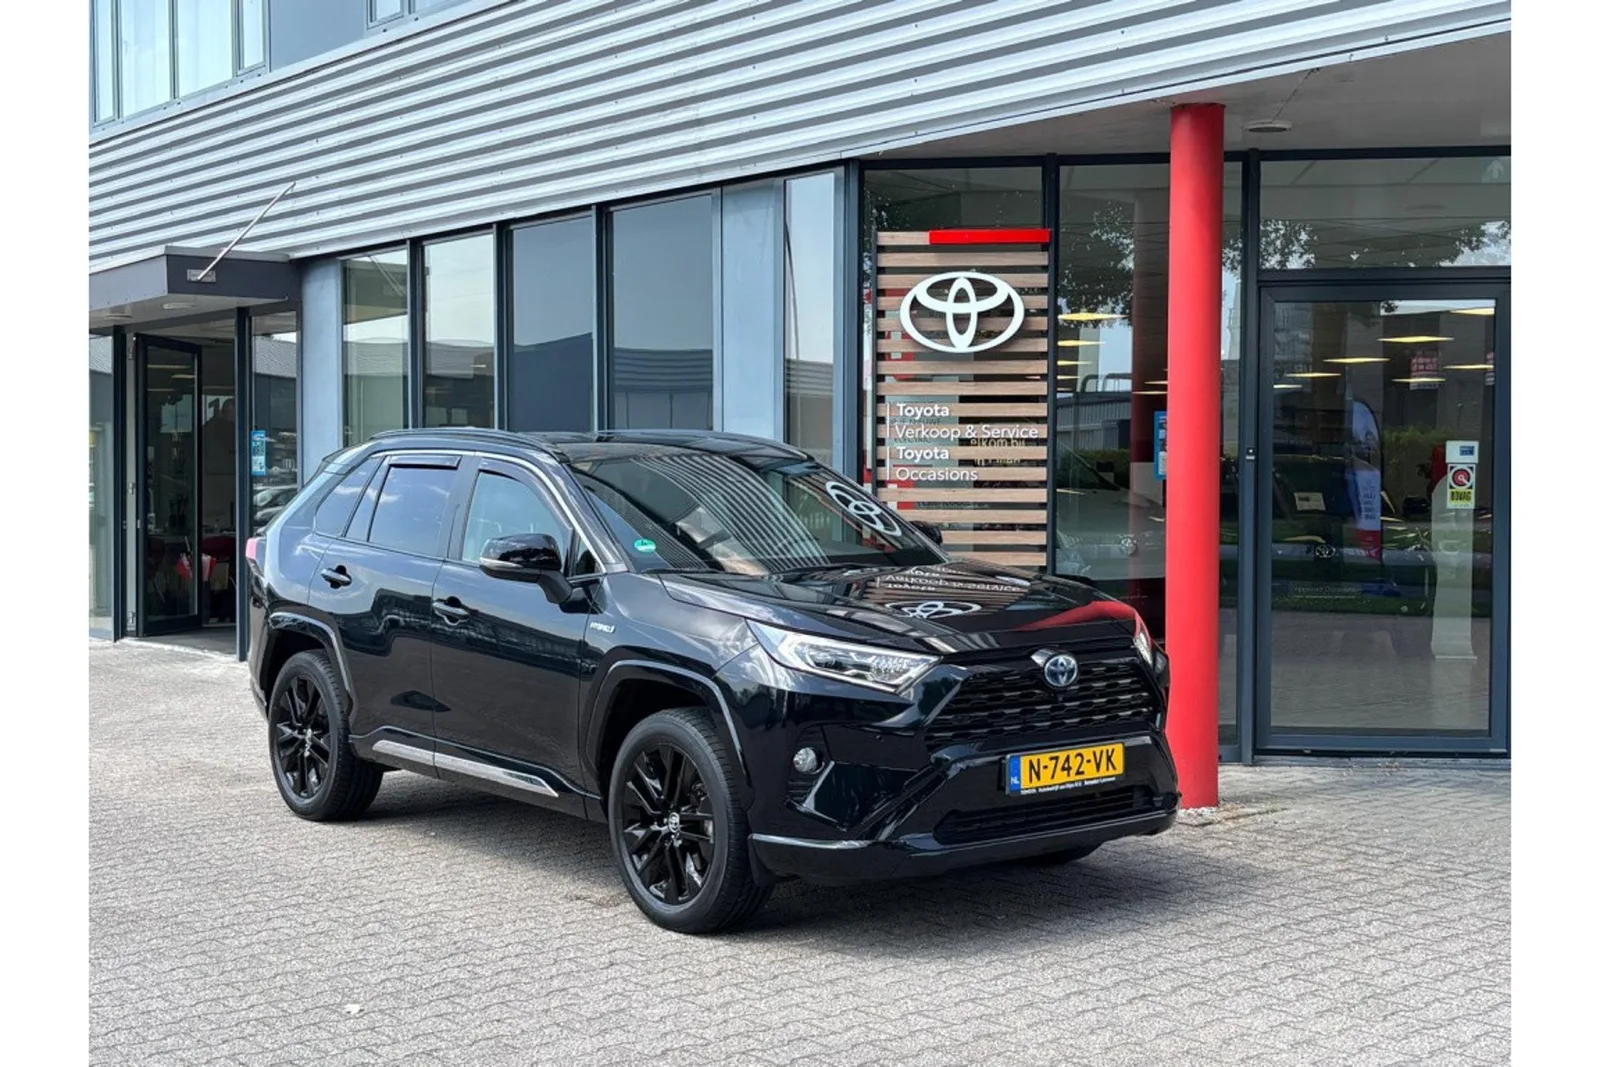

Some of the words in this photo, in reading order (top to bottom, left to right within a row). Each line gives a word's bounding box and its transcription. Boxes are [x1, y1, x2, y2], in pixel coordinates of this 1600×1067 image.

[897, 403, 950, 420] Toyota
[895, 424, 961, 441] Verkoop
[965, 424, 978, 439] &
[982, 424, 1040, 439] Service
[897, 446, 950, 462] Toyota
[896, 467, 979, 481] Occasions
[1029, 748, 1116, 783] N-742-VK
